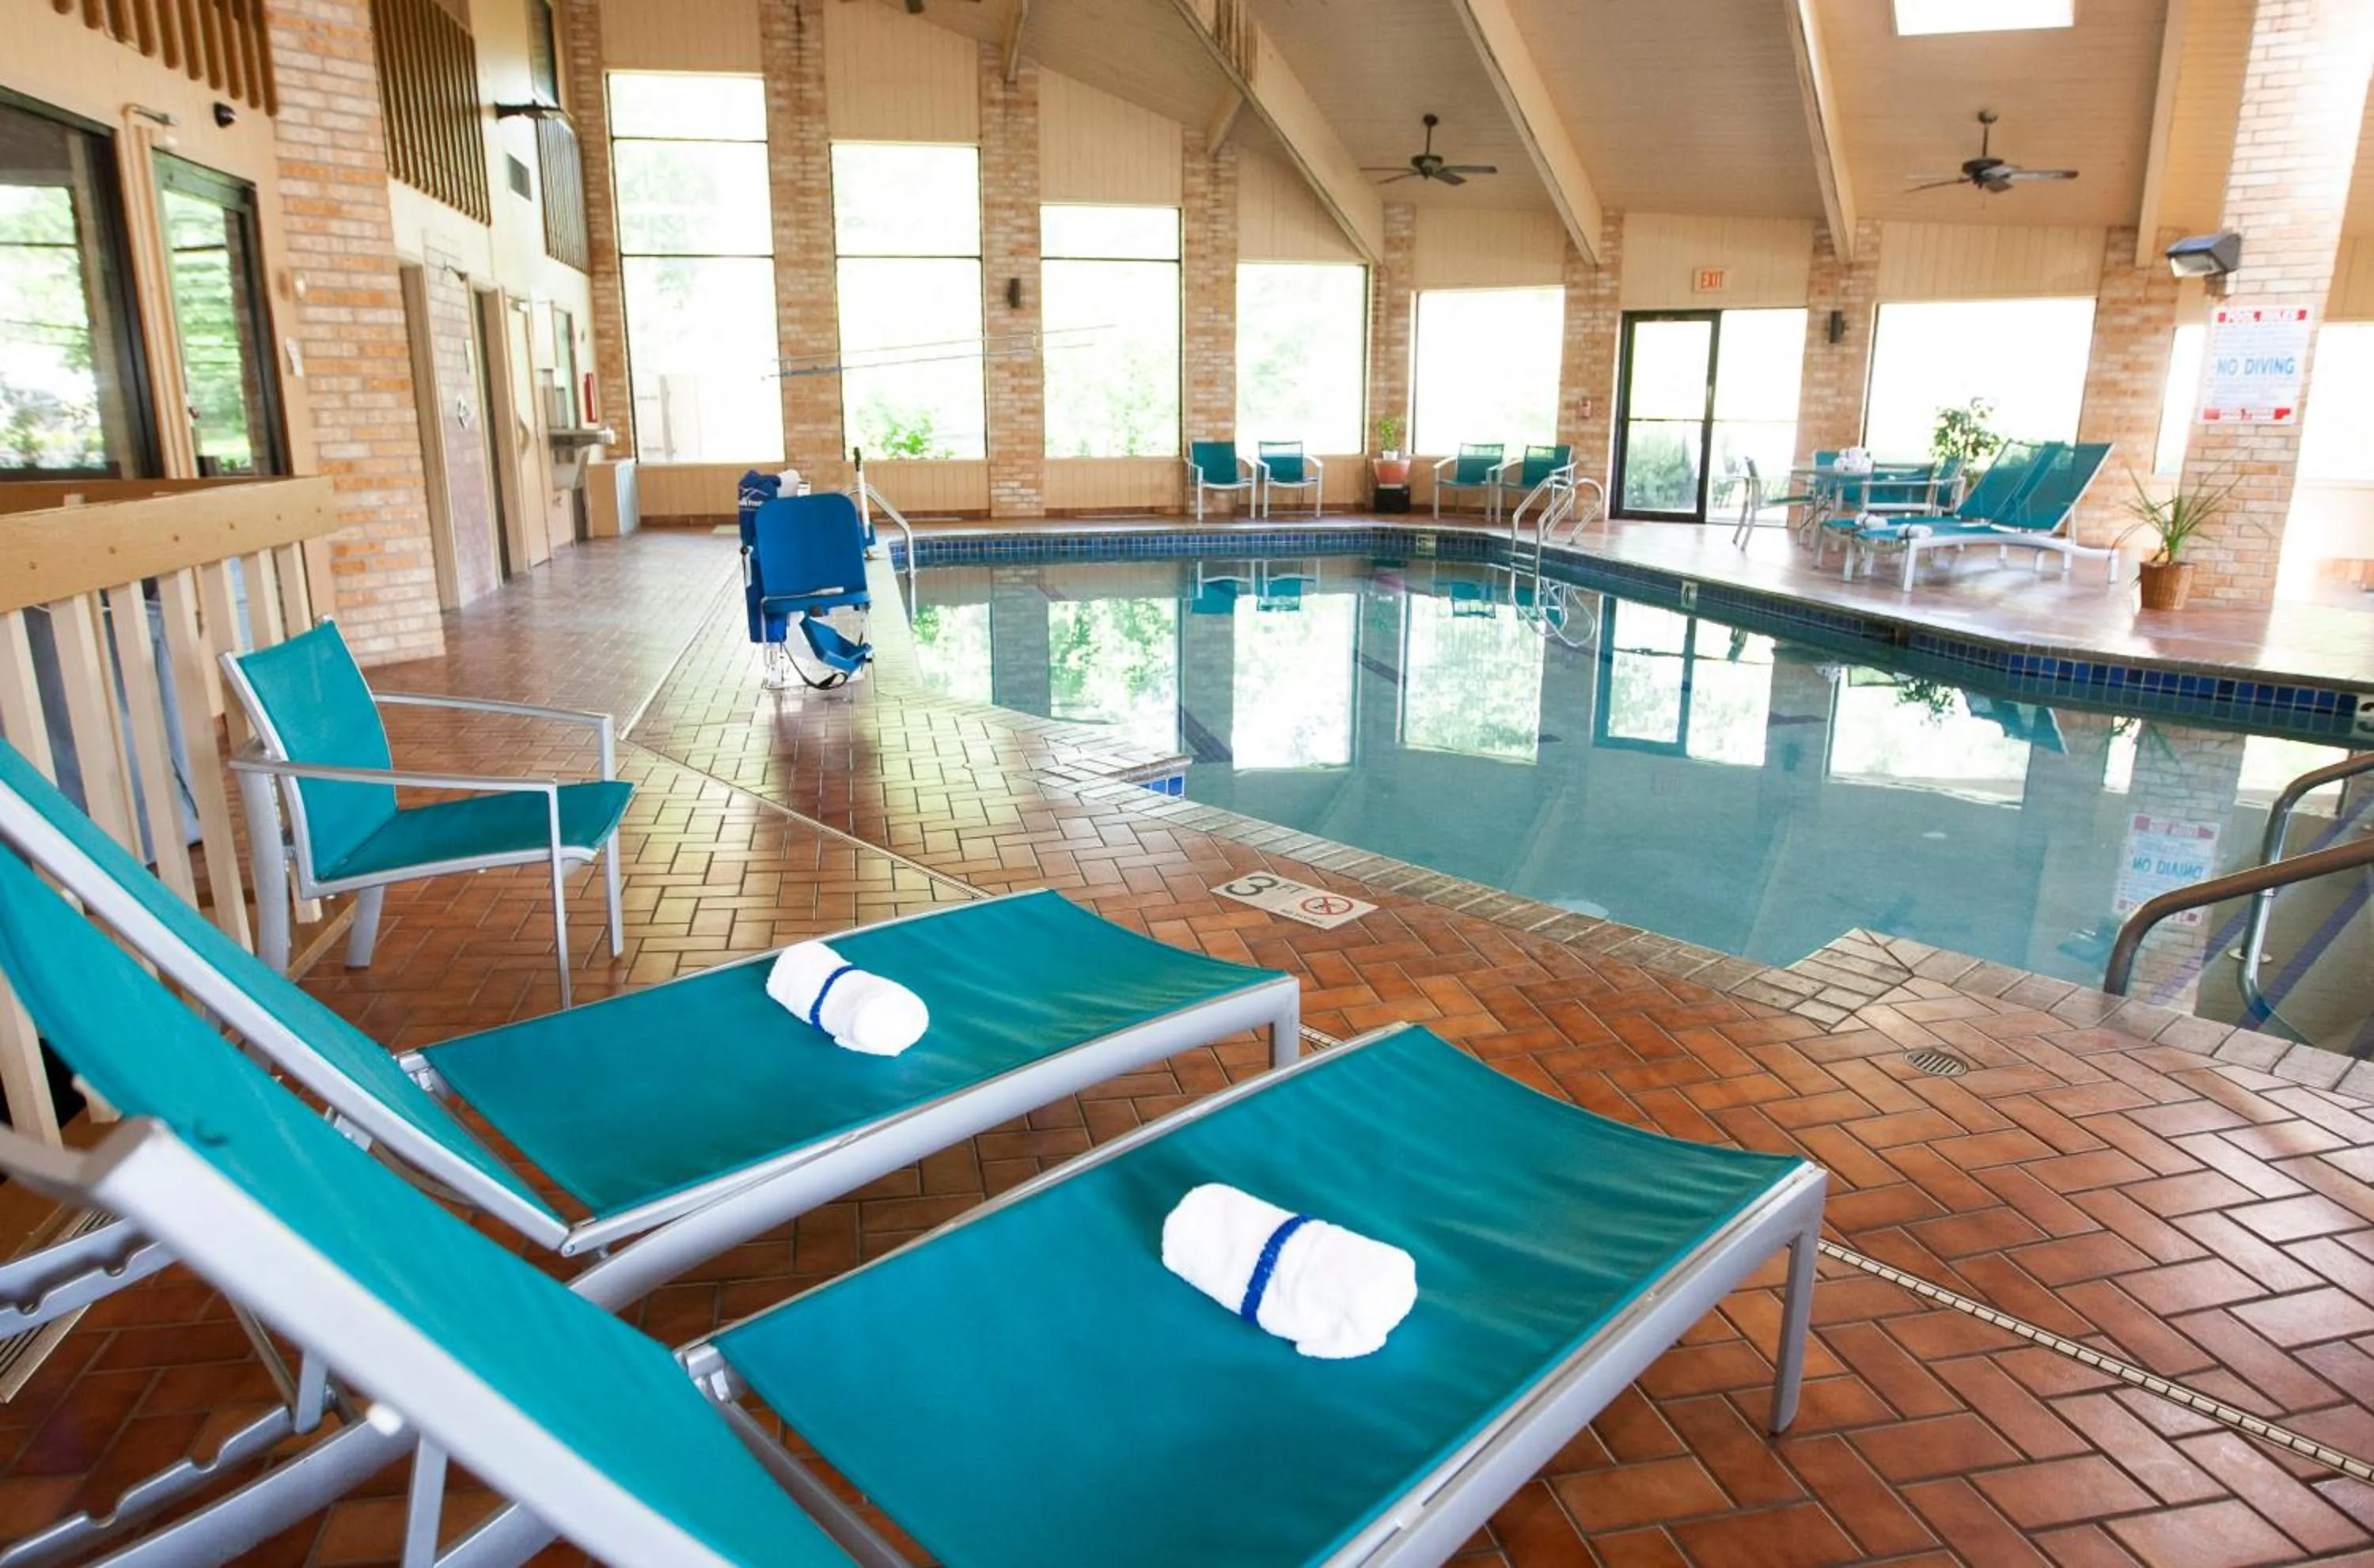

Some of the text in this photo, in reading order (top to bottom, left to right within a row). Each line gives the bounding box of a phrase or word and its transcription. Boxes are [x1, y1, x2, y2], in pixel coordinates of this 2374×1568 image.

[1701, 272, 1724, 288] EXIT
[2217, 358, 2295, 375] NO DIVING
[1224, 876, 1279, 896] 3
